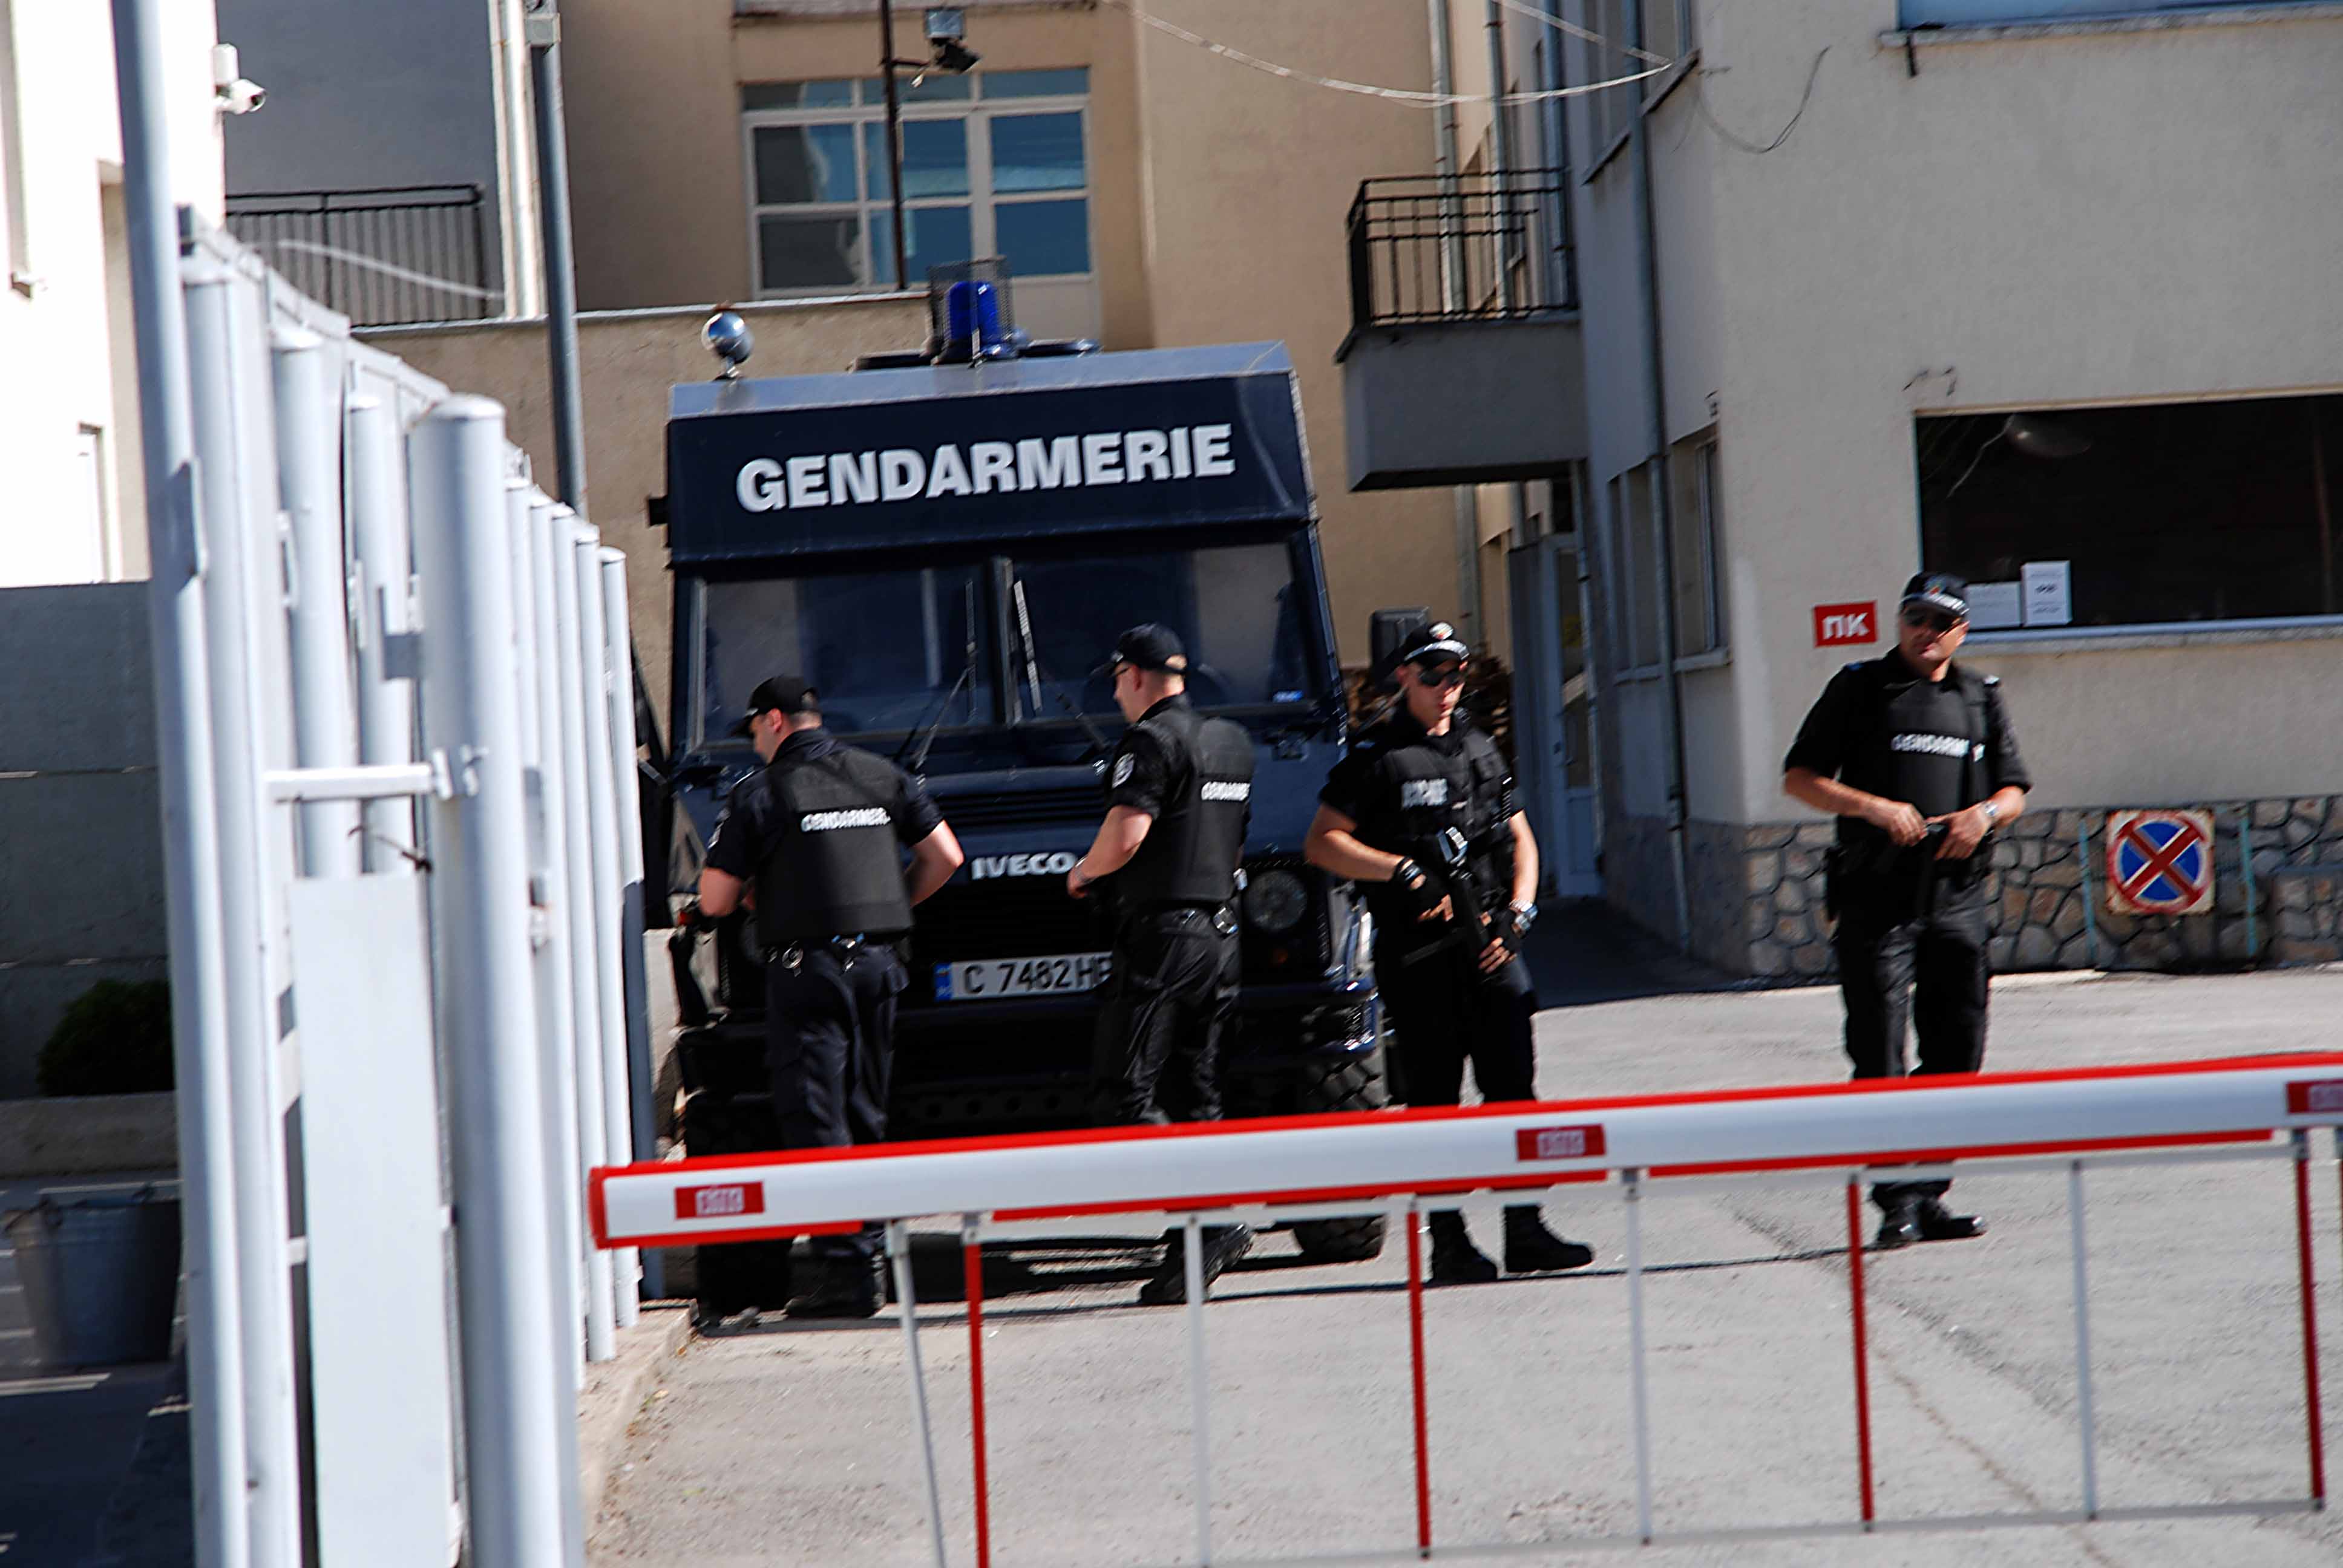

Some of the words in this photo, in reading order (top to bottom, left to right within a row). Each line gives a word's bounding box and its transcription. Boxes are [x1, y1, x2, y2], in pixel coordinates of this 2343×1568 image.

[737, 423, 1236, 514] GENDARMERIE
[1822, 612, 1870, 639] ПК
[971, 852, 1076, 881] IVECO
[963, 964, 986, 995] C
